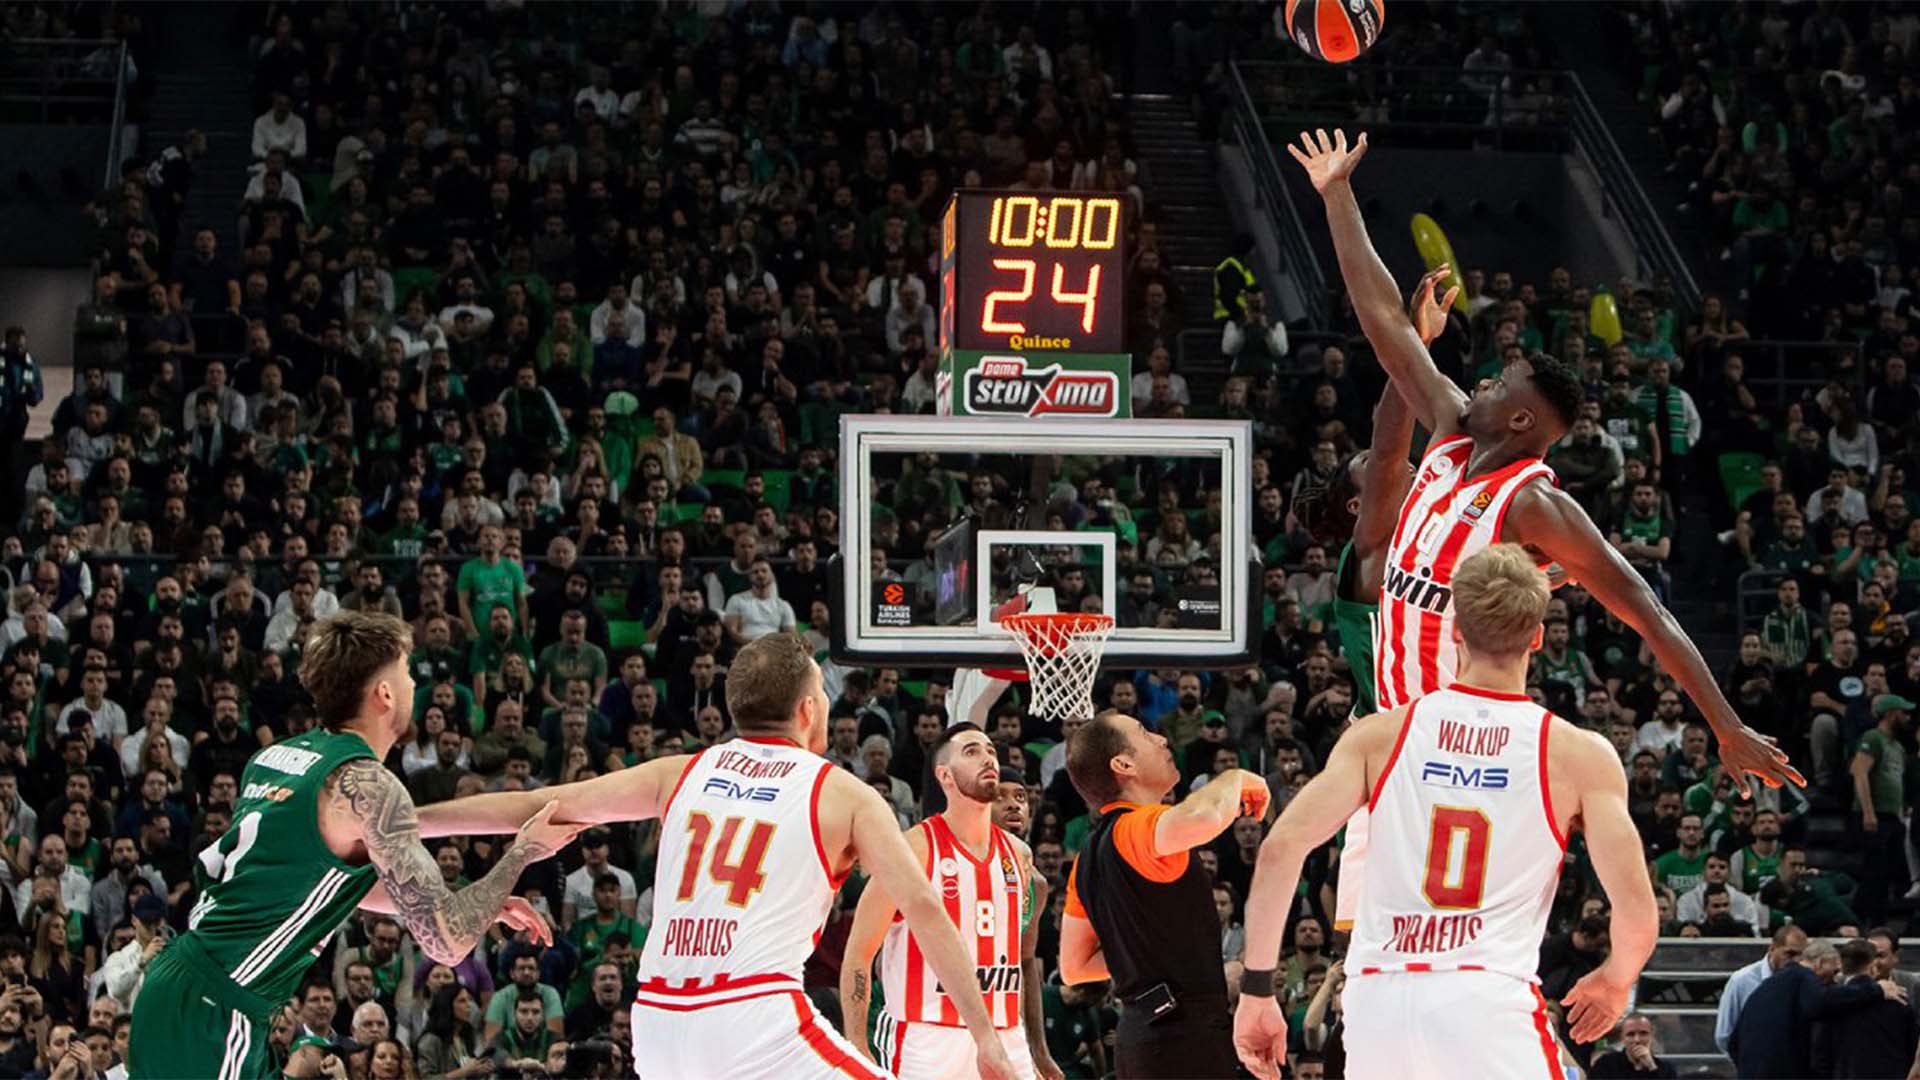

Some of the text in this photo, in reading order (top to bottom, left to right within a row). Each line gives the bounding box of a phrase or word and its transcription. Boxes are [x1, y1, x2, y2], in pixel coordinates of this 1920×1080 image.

[989, 197, 1119, 249] 10:00
[981, 259, 1101, 334] 24
[1009, 335, 1071, 349] Quince
[1386, 563, 1451, 613] win
[1437, 719, 1510, 756] WALKUP
[714, 750, 798, 779] VEZENKOV
[1422, 761, 1509, 788] FMS
[703, 778, 780, 802] FMS
[676, 809, 778, 909] 14
[1421, 803, 1493, 911] 0
[662, 917, 738, 957] PIRAEUS
[976, 900, 995, 937] 8
